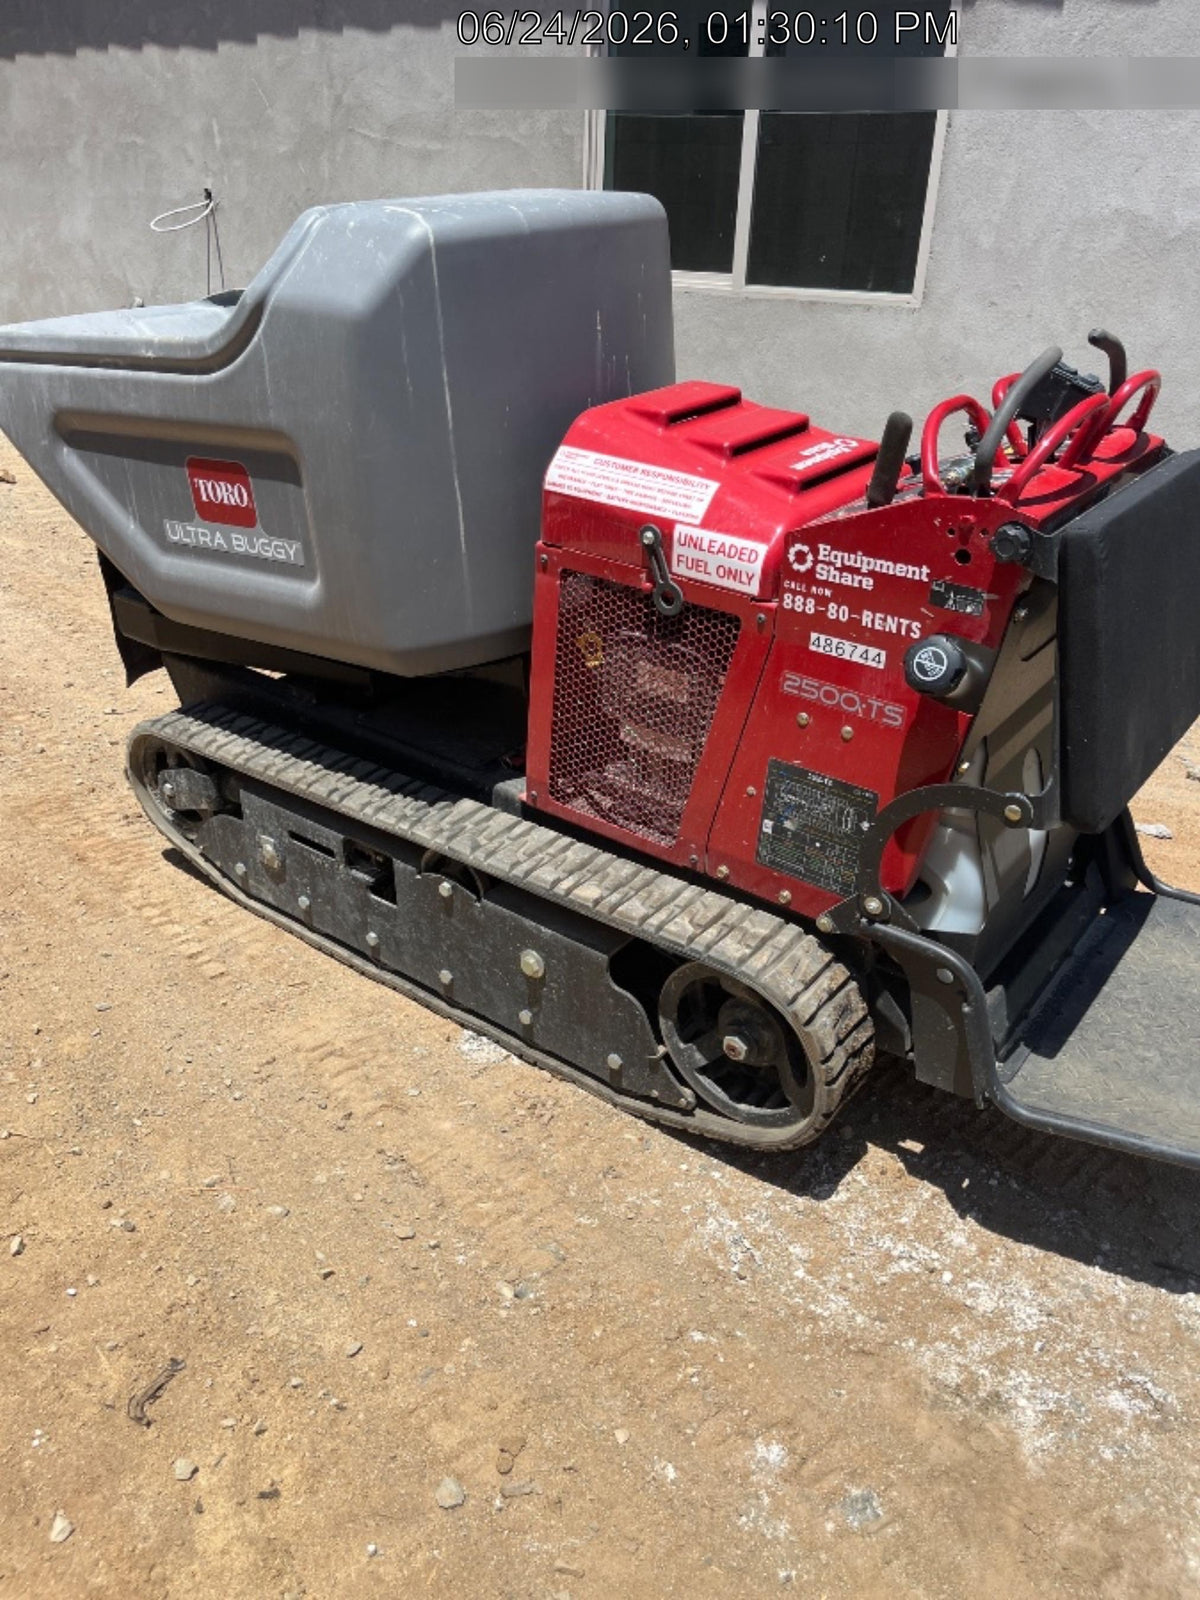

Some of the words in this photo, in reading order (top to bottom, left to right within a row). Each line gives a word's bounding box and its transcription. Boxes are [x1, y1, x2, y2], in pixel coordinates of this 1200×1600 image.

[593, 457, 640, 475] CUSTOMER
[640, 463, 711, 490] RESPONSIBILITY
[194, 478, 248, 508] TORO
[166, 522, 227, 548] ULTRA
[231, 532, 296, 561] BUGGY
[677, 532, 759, 565] UNLEADED
[676, 554, 712, 577] FUEL
[715, 564, 756, 588] ONLY
[815, 564, 875, 591] Share
[817, 544, 931, 583] Equipment
[783, 580, 807, 593] CALL
[810, 585, 833, 599] NOW
[782, 593, 922, 640] 888-80-RENTS
[811, 635, 884, 666] 486744
